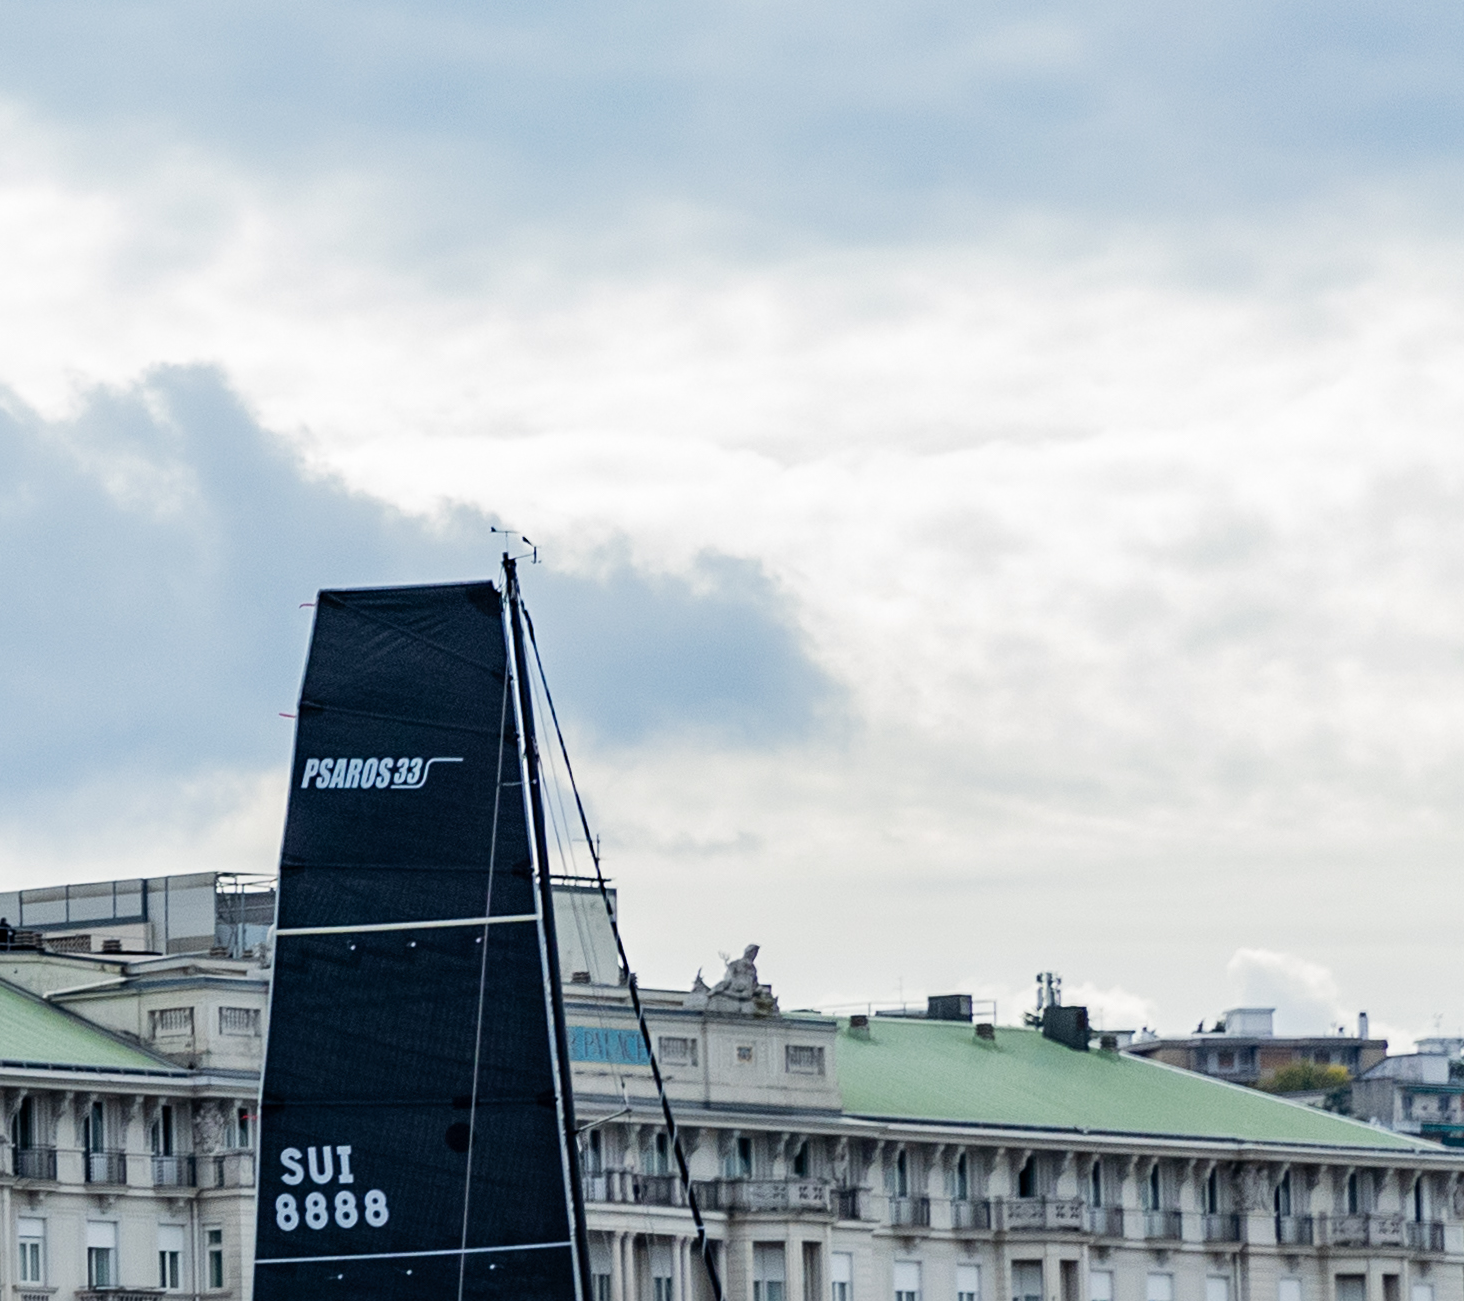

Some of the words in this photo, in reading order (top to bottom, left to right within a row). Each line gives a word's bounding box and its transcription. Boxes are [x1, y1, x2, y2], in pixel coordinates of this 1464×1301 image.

[300, 757, 394, 789] PSAROS
[392, 757, 425, 786] 33
[280, 1145, 354, 1186] SUI
[275, 1189, 390, 1232] 8888
